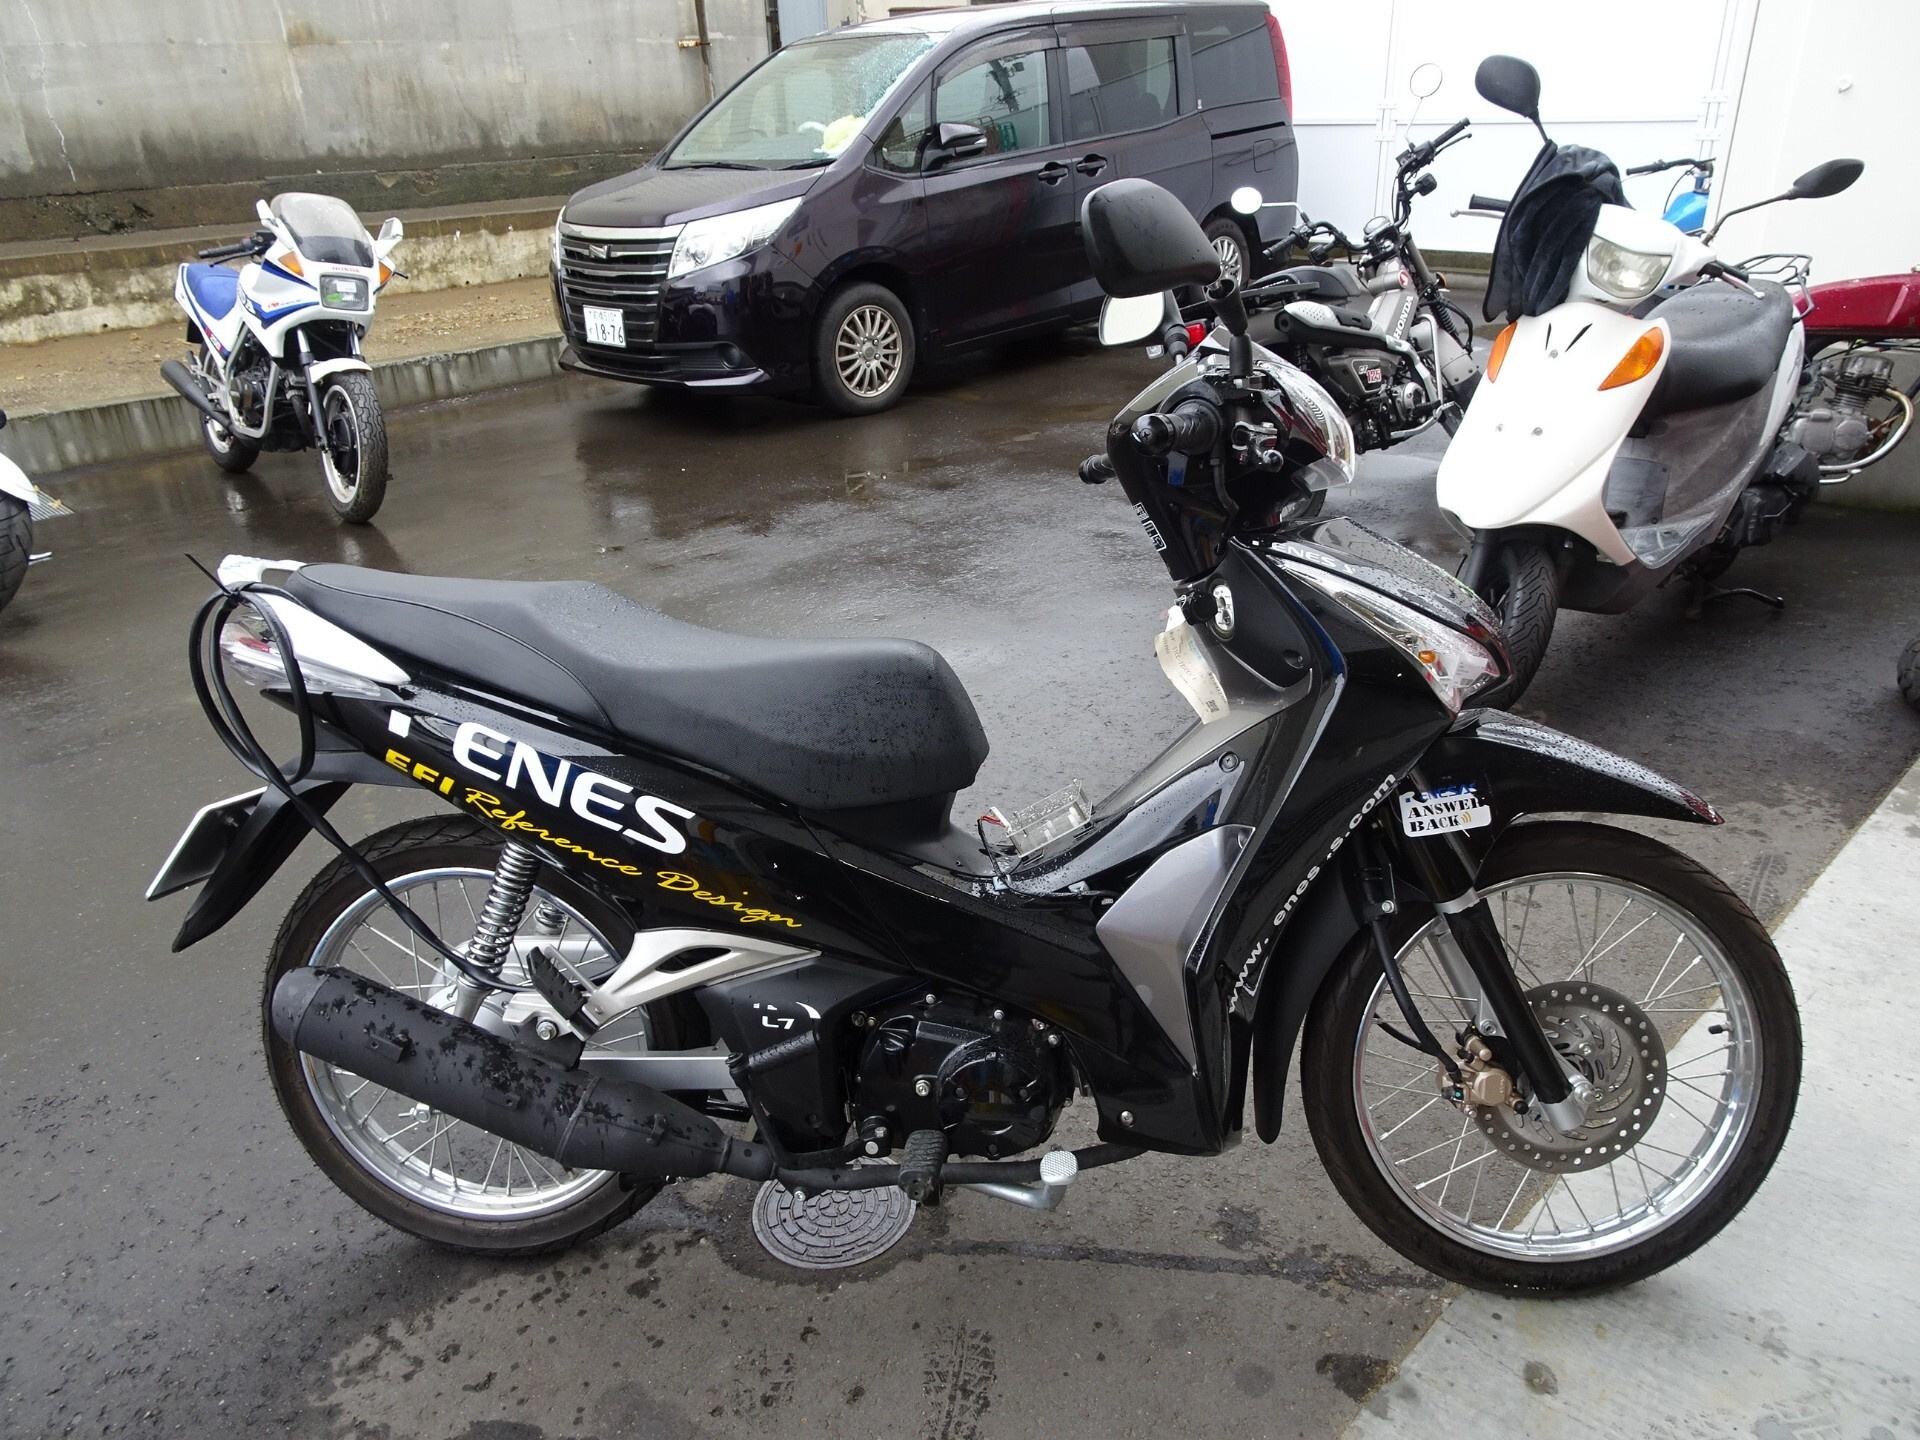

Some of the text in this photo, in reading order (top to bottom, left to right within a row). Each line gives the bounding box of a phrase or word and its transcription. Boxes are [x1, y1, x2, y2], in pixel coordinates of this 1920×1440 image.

[1393, 295, 1414, 339] HONDA
[594, 322, 624, 344] 18-76
[1366, 368, 1382, 384] 125
[1409, 815, 1460, 833] BACK
[385, 749, 802, 929] EFI Reference Design
